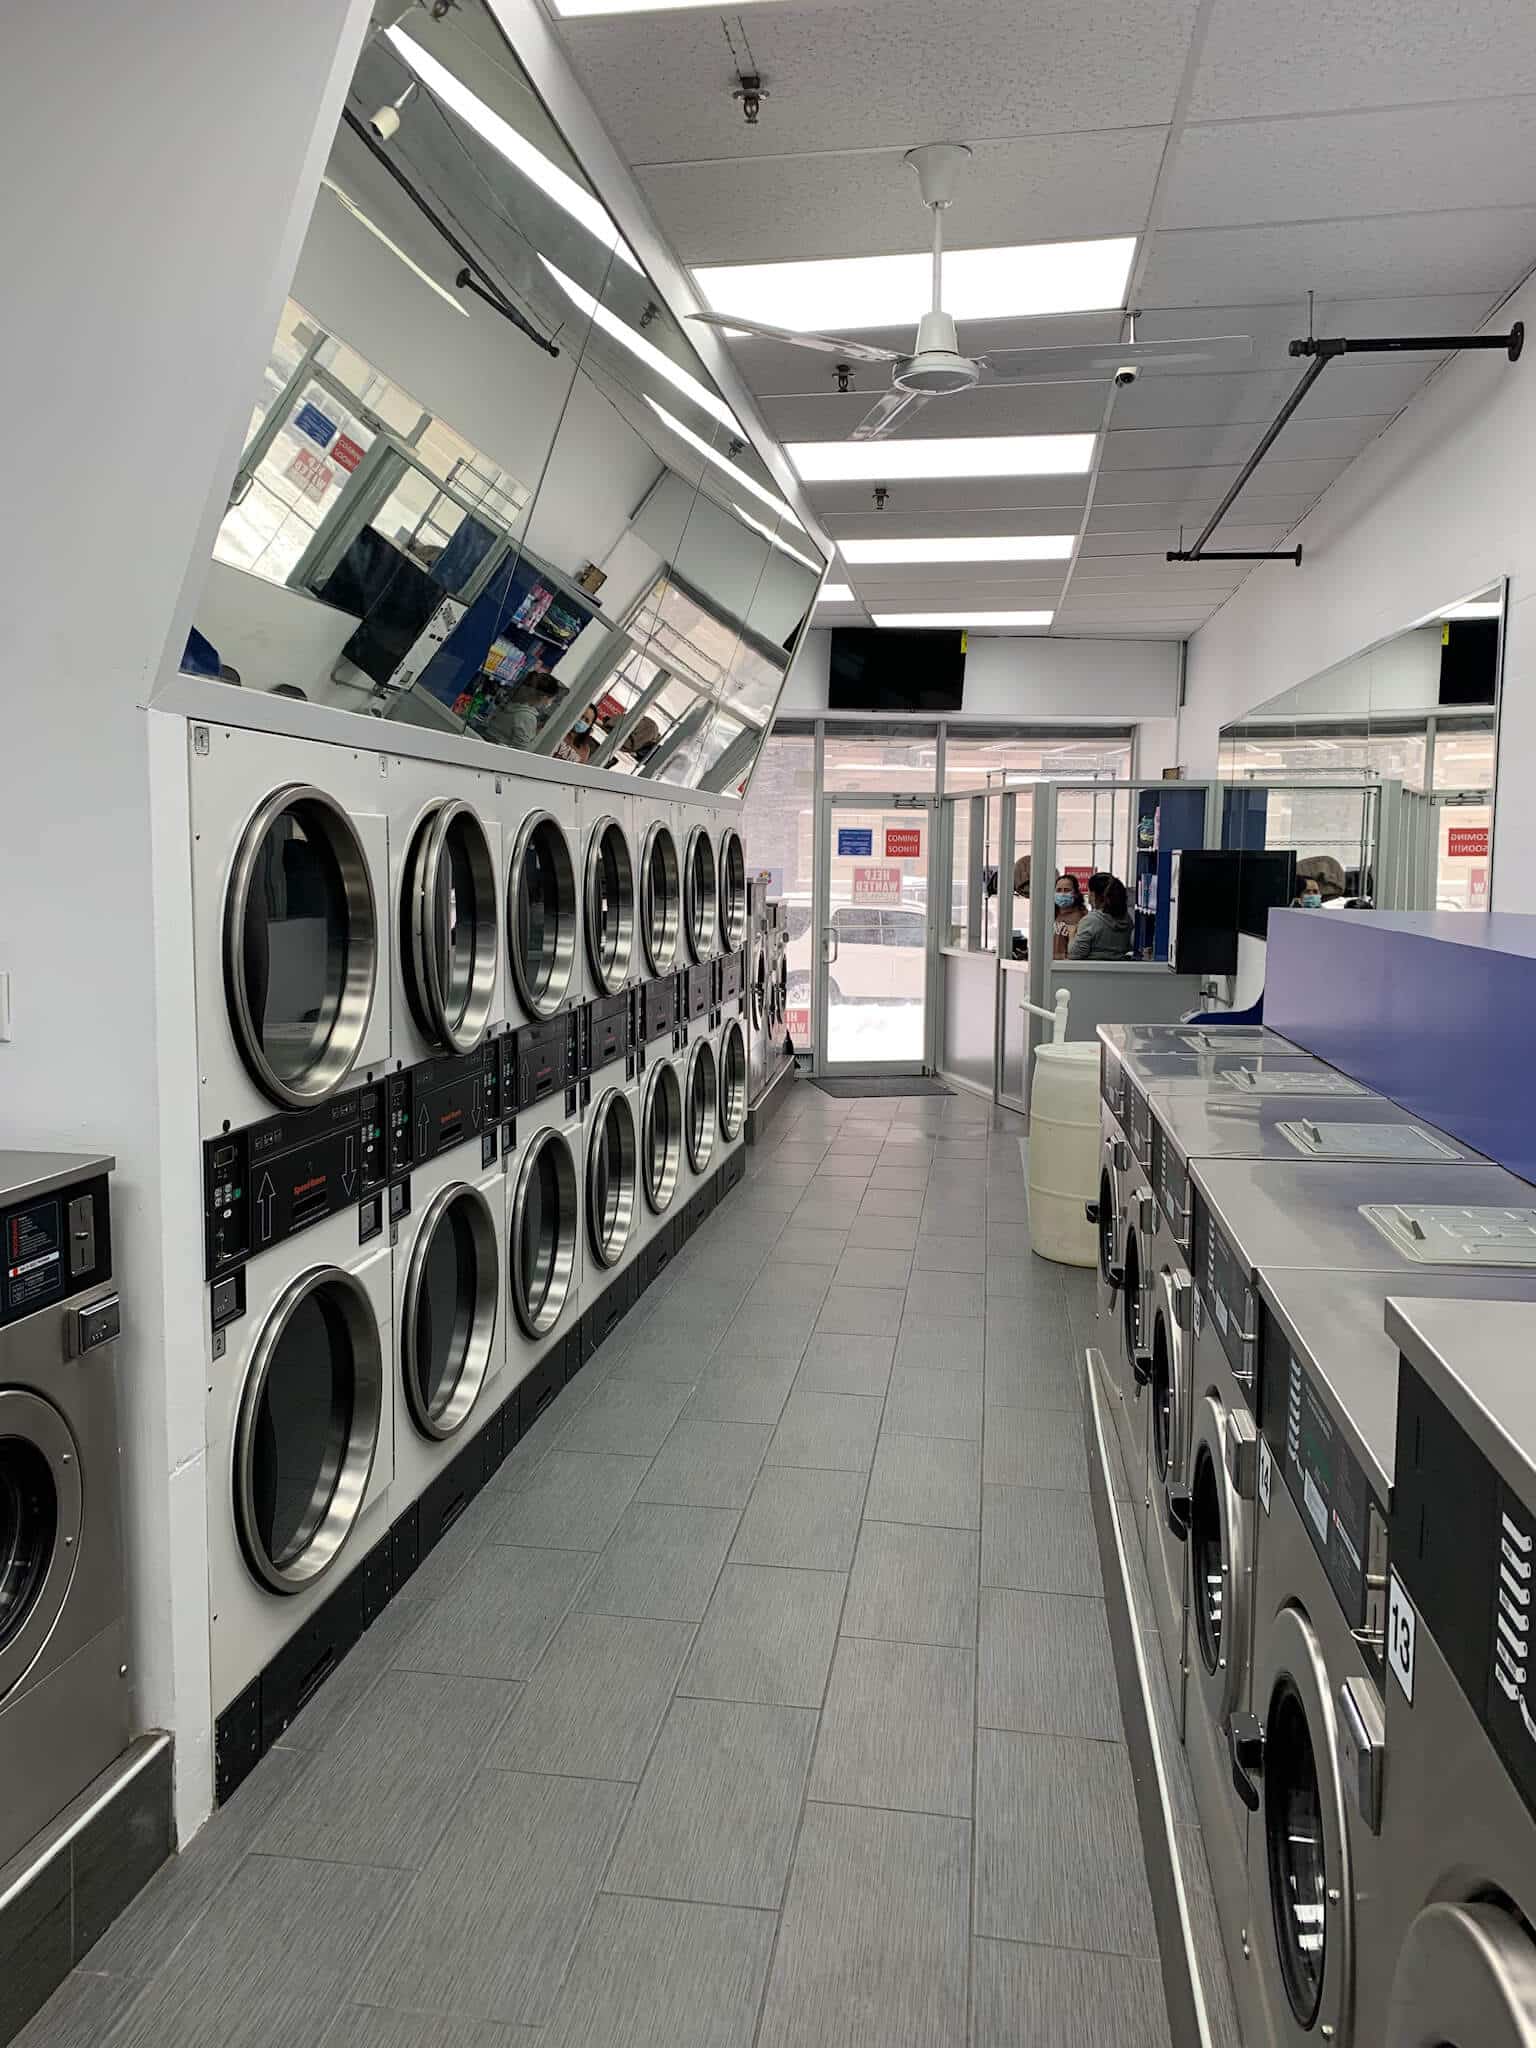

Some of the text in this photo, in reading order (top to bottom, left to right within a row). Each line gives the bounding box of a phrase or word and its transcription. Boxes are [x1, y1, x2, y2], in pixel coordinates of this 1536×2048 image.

[887, 834, 919, 842] COMING
[1261, 1454, 1269, 1497] 14
[1392, 1603, 1410, 1673] 13
